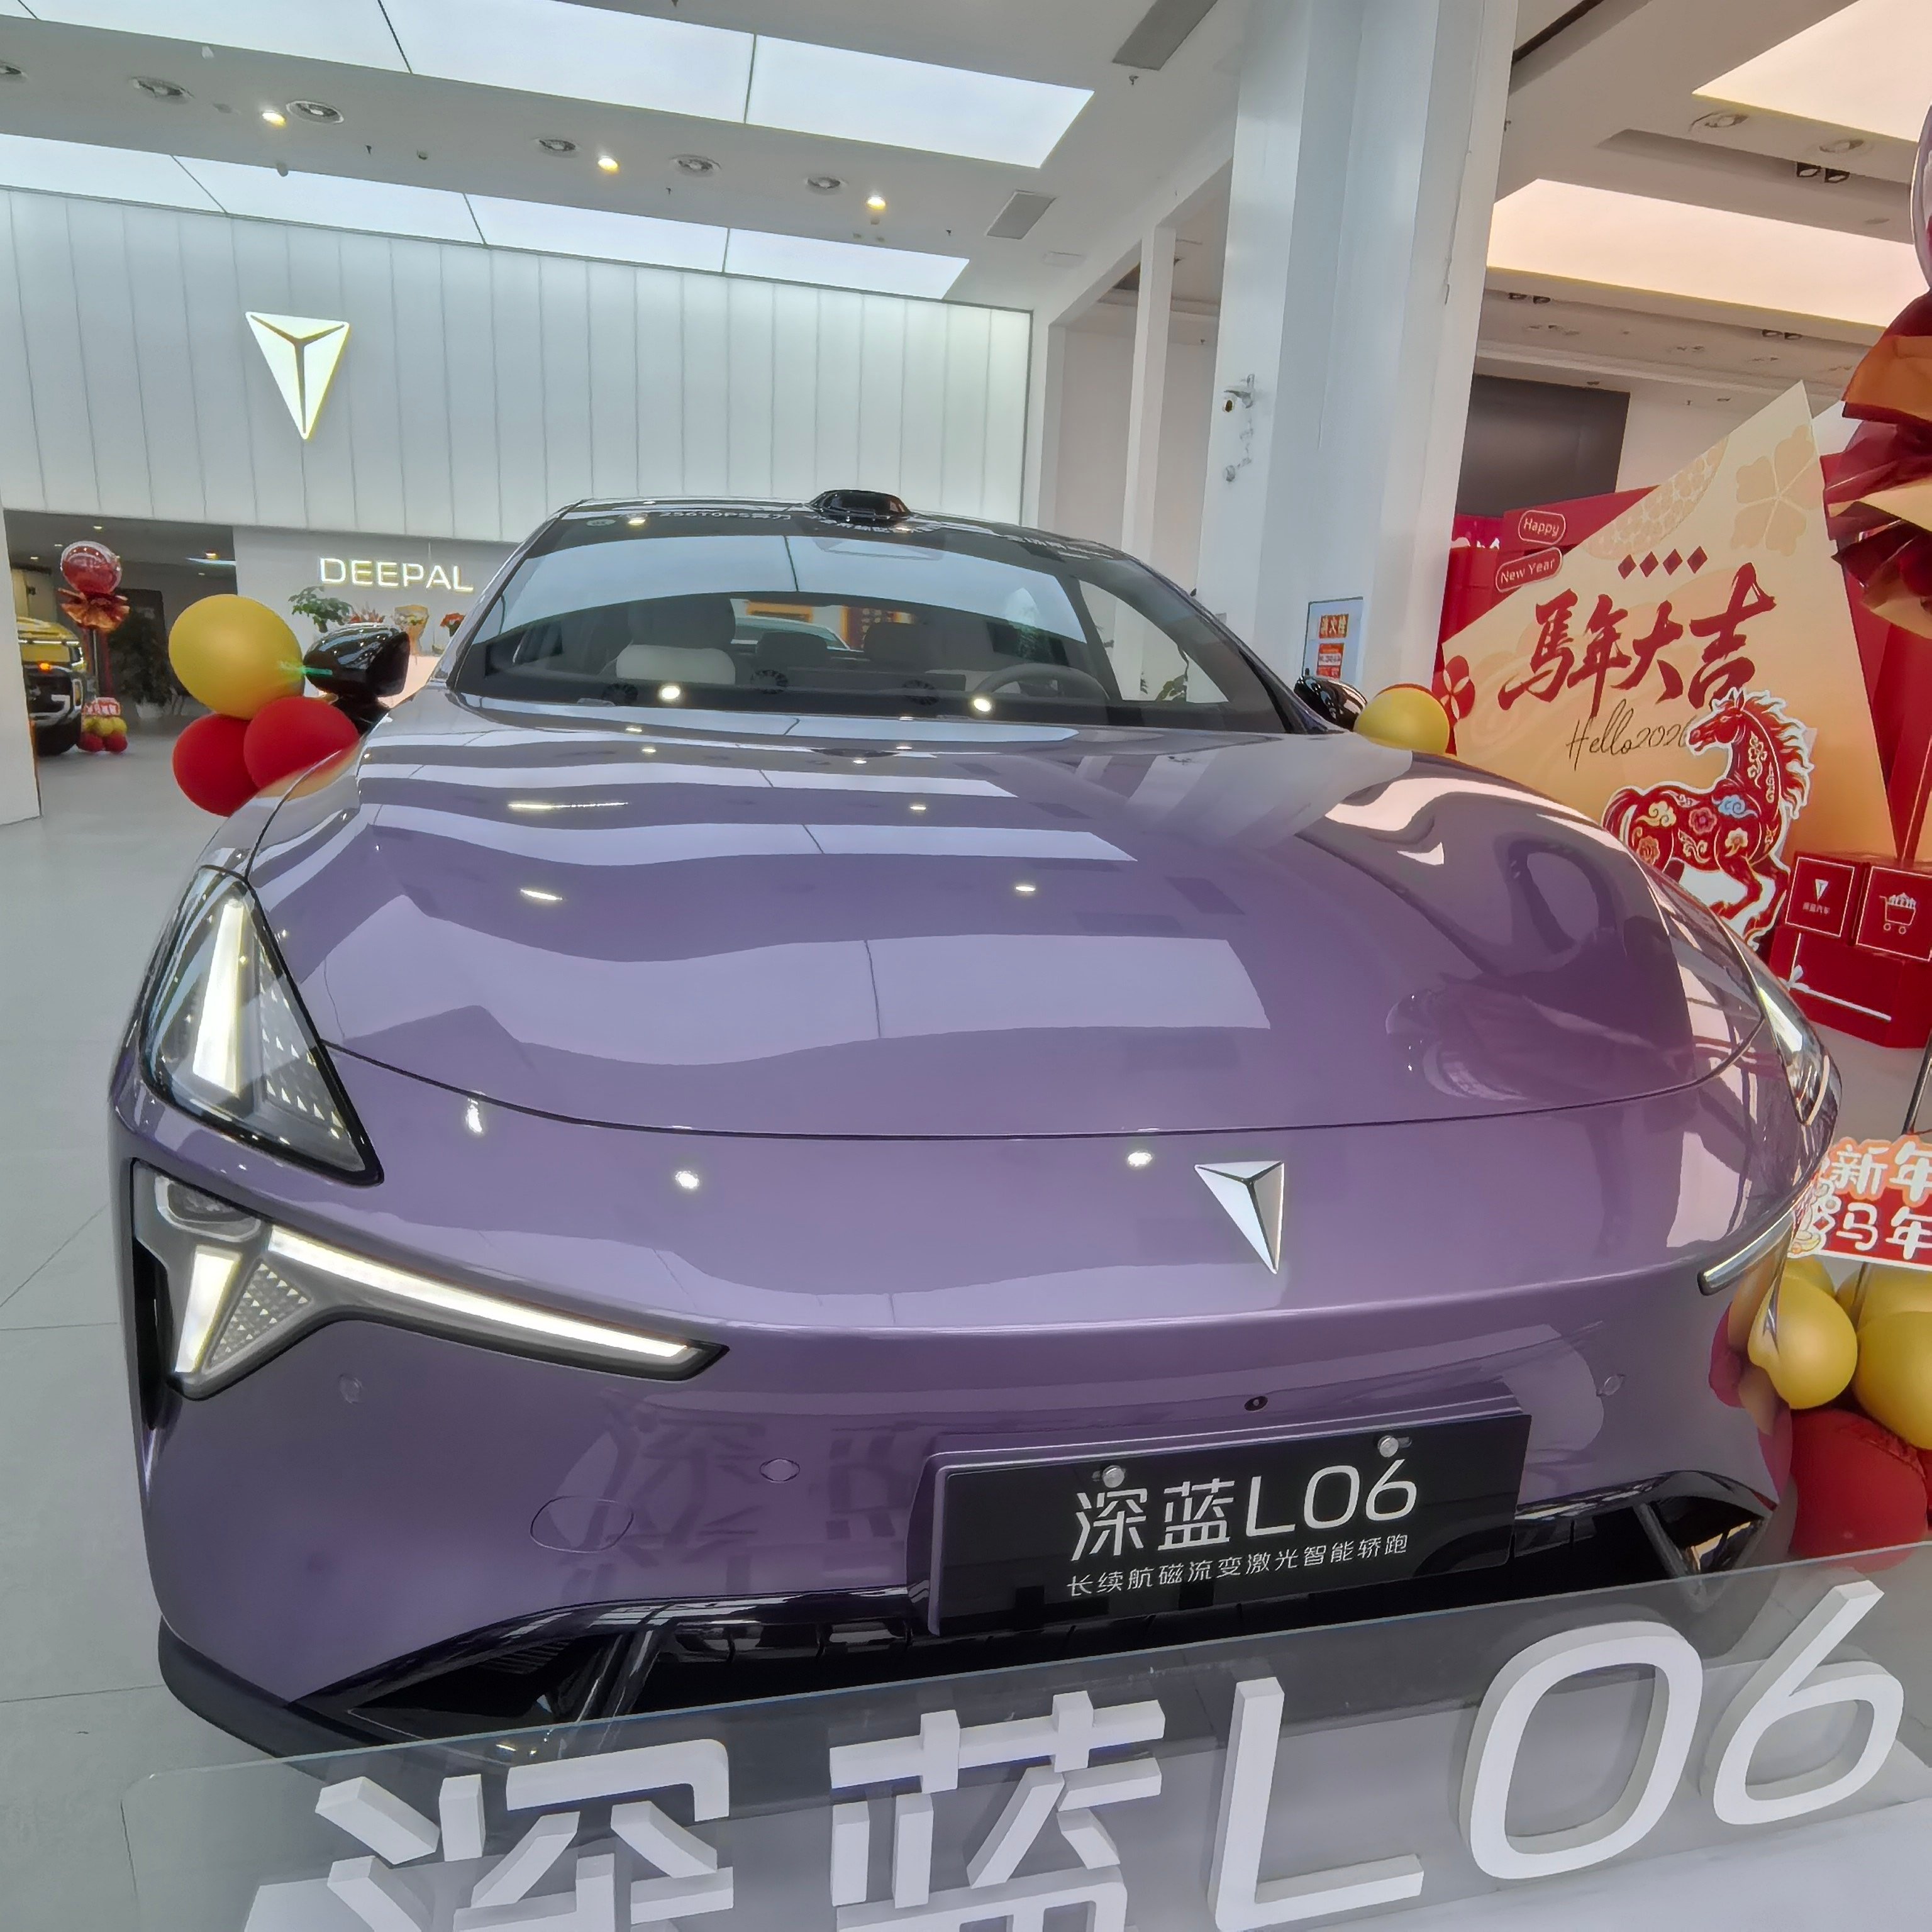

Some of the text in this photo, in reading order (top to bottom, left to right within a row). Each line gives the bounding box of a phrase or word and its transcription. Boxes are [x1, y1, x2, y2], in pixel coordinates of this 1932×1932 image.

[1523, 518, 1560, 536] Happy
[319, 558, 474, 591] DEEPAL
[1501, 558, 1556, 584] New Year
[1070, 1458, 1418, 1562] 深蓝L06
[1067, 1533, 1408, 1597] 长续航磁流变激光智能轿跑
